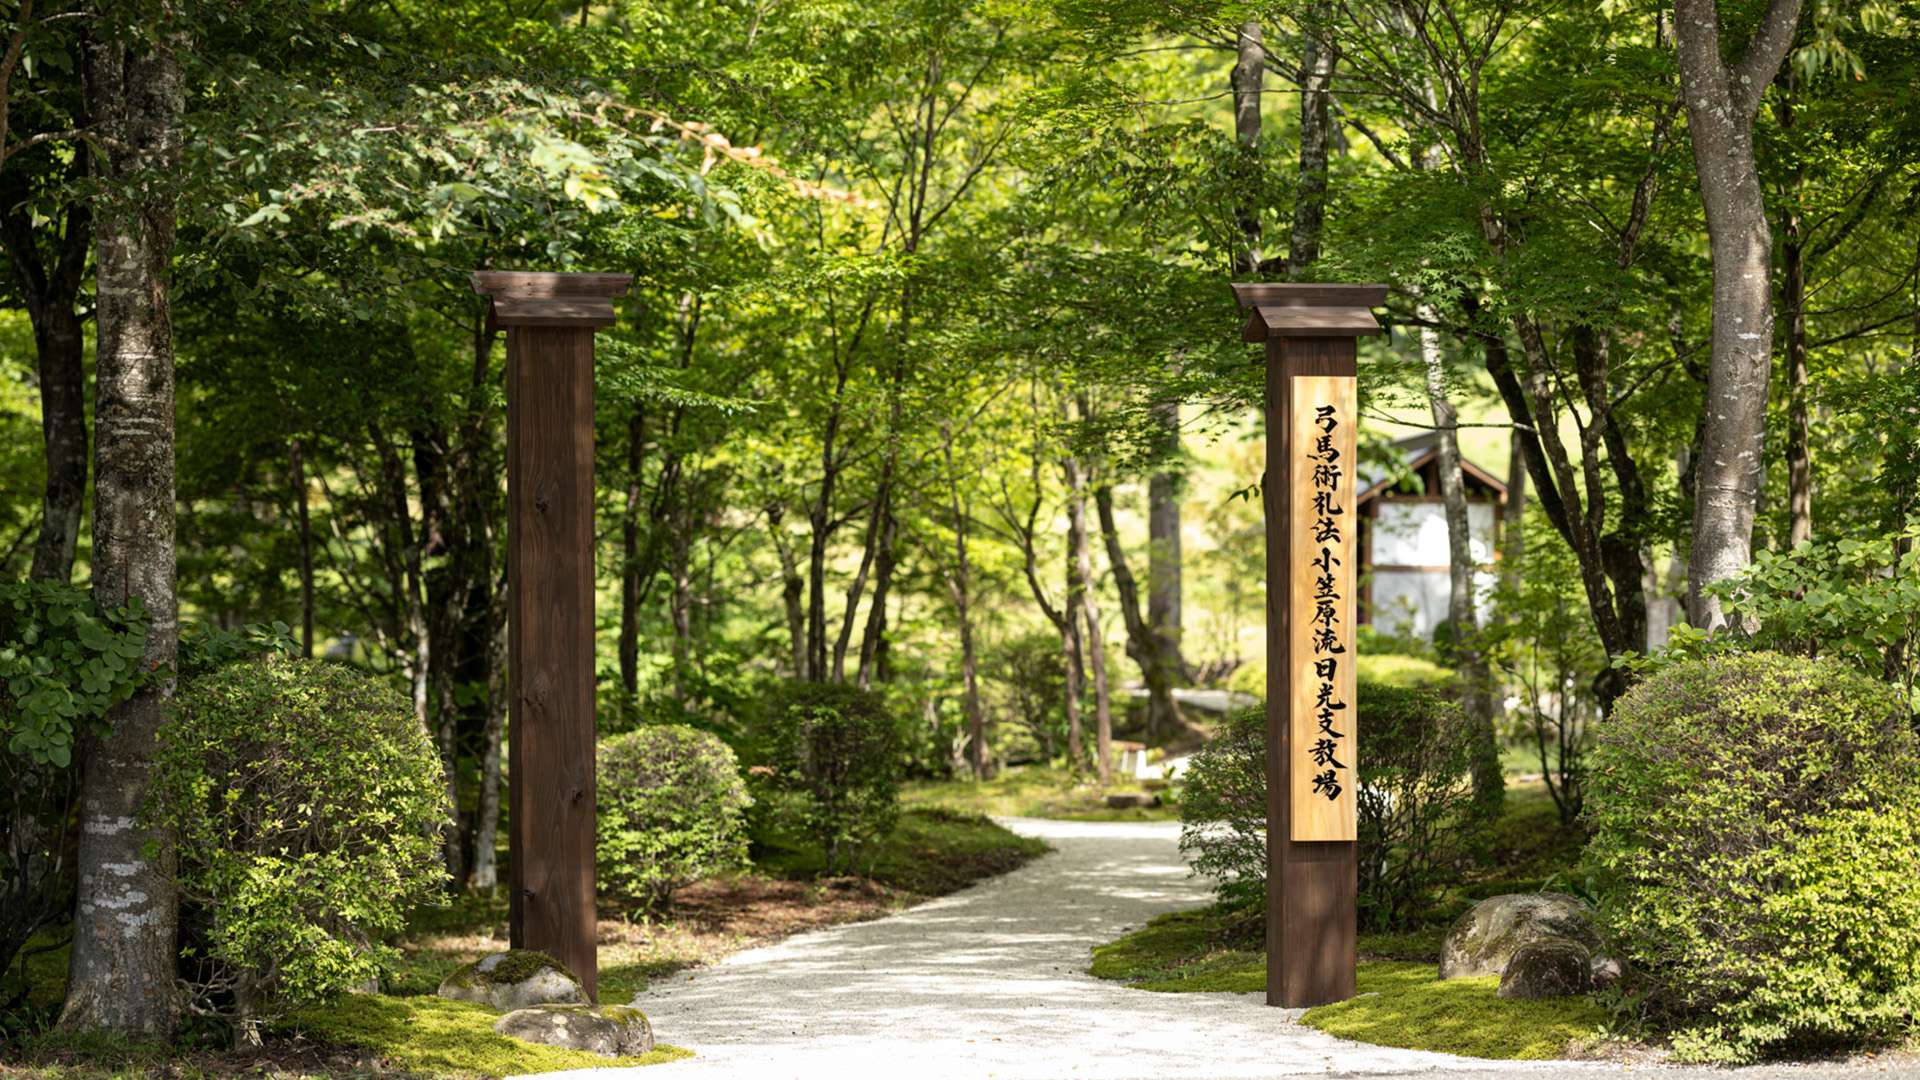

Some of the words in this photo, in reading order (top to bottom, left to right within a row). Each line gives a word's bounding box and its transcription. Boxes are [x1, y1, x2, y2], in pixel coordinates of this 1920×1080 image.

[1307, 404, 1347, 801] 弓馬術礼法小笠原流日光支教場
